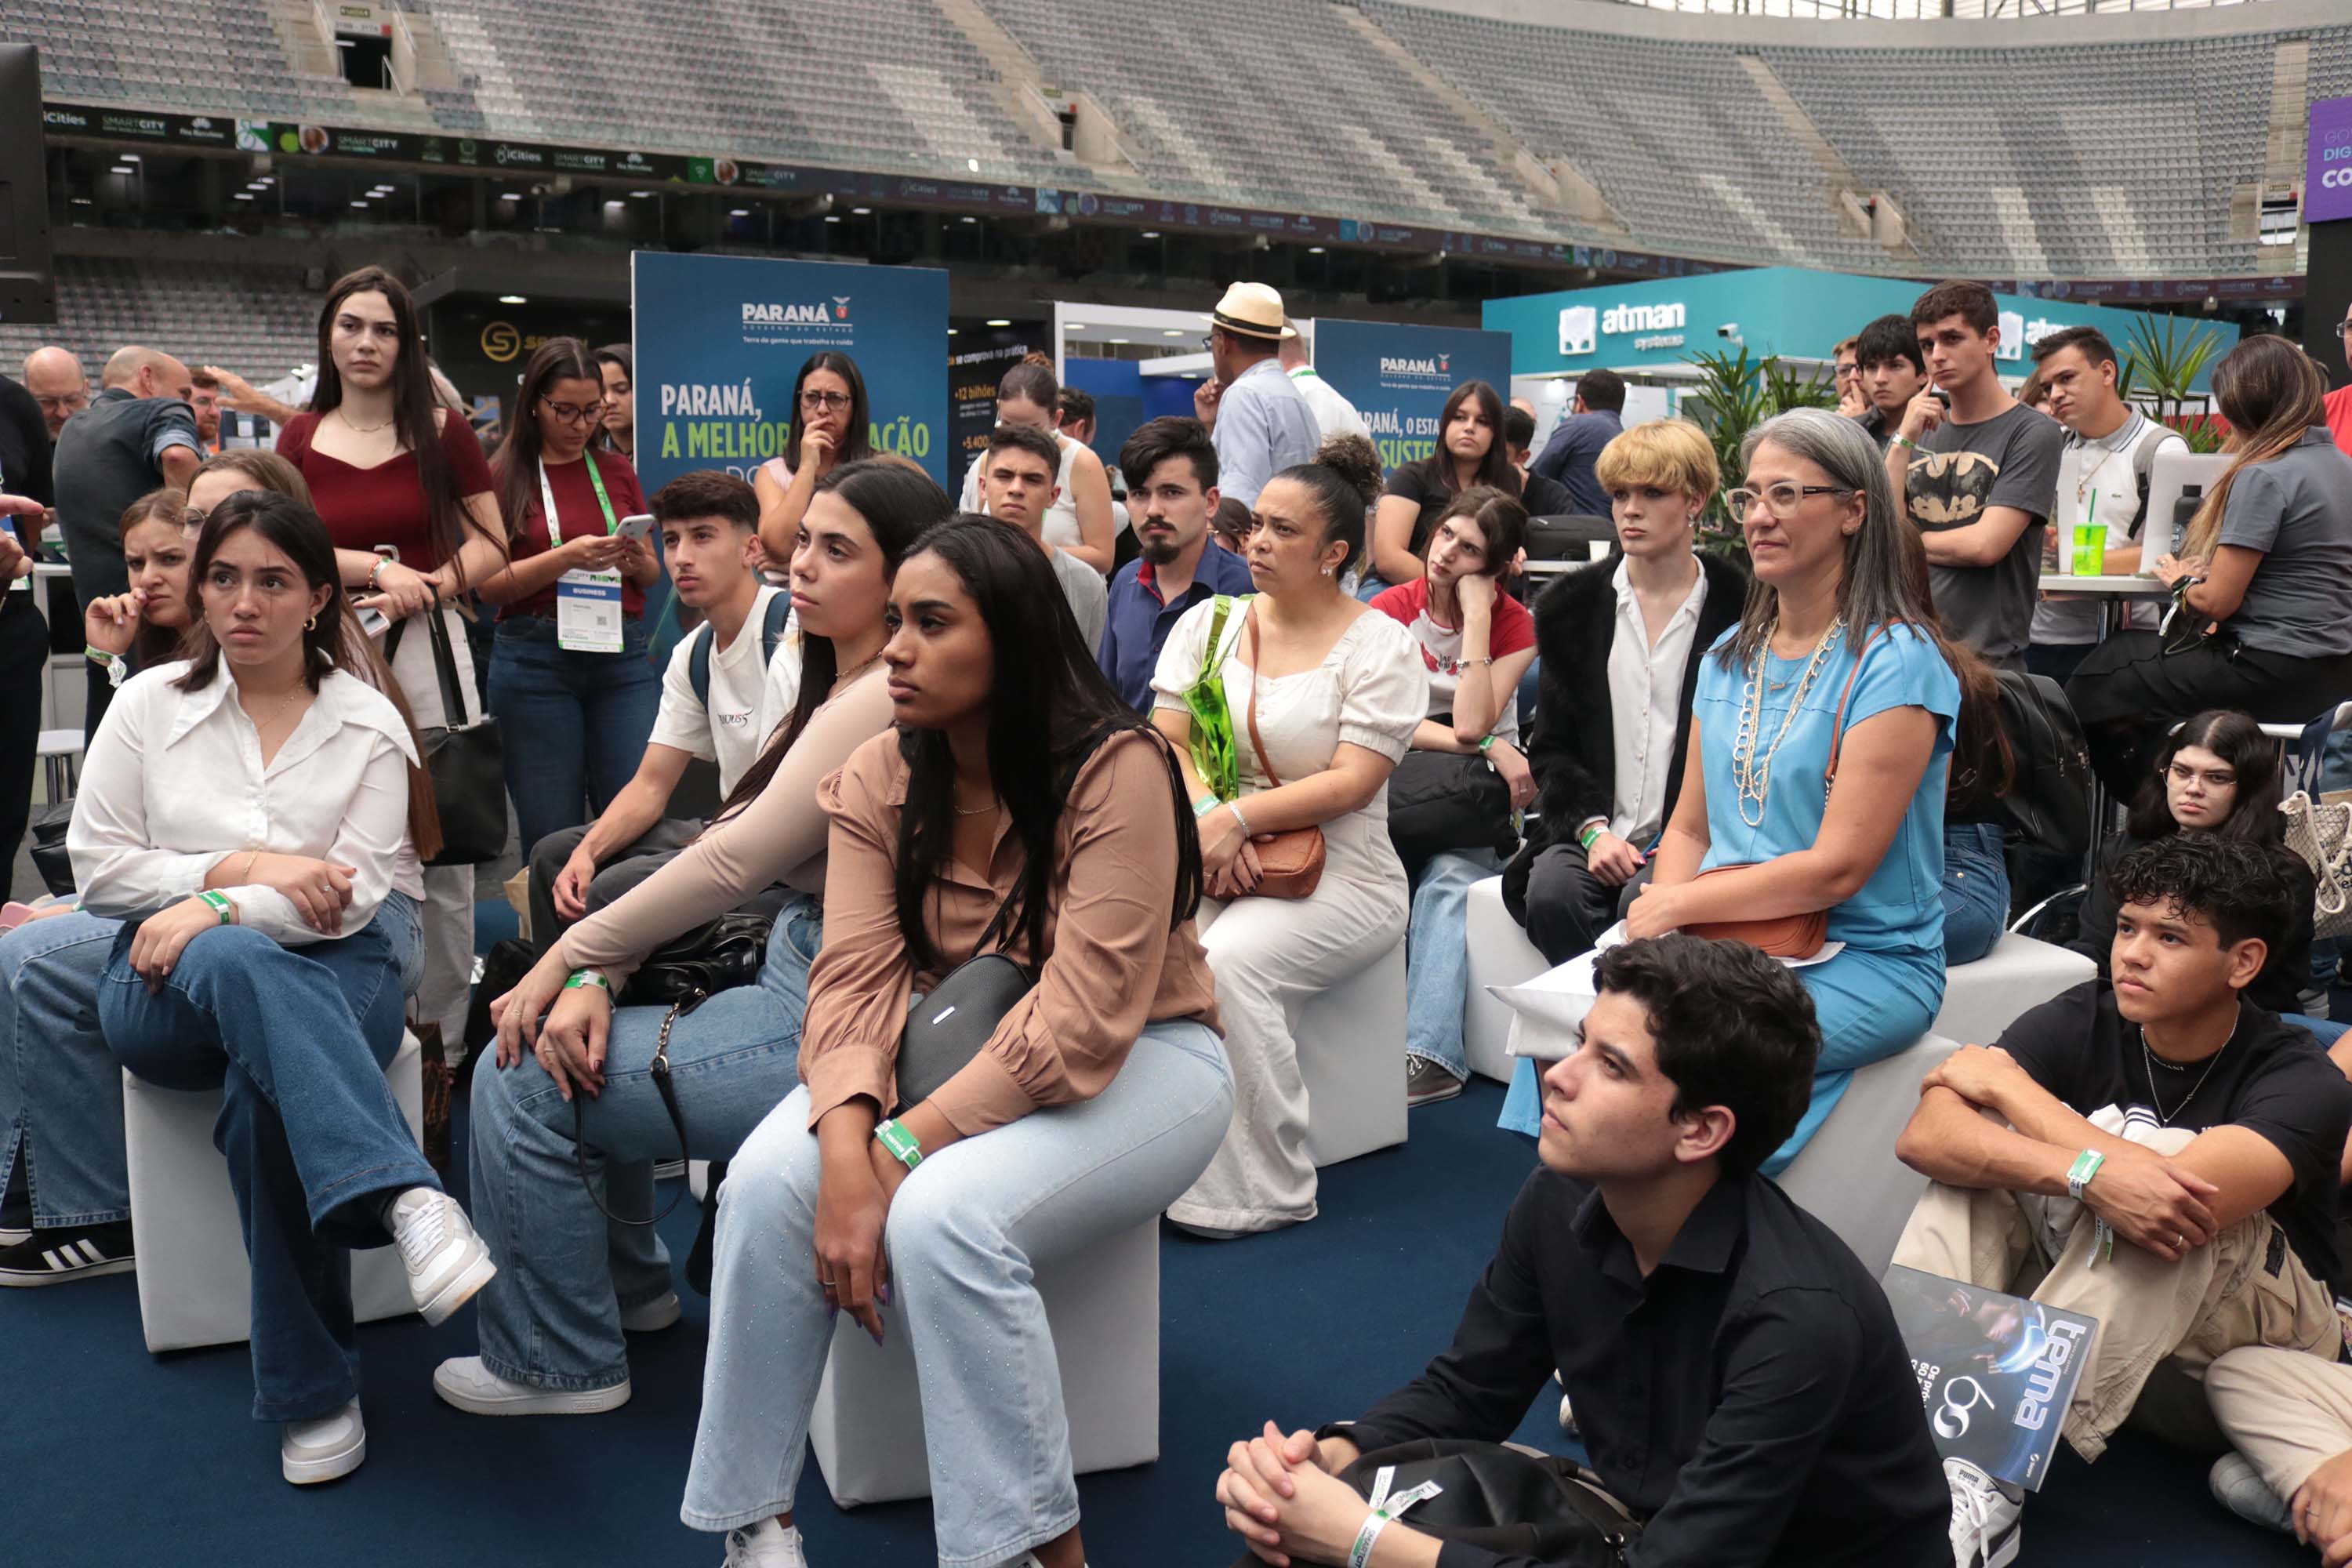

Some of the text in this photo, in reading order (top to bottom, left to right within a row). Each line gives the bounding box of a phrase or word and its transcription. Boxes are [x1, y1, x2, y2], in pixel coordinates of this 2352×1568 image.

[742, 303, 830, 322] PARANÁ
[1602, 303, 1686, 335] atman
[1380, 358, 1436, 373] PARANÁ
[660, 378, 762, 422] PARANÁ,
[1358, 408, 1440, 437] RANÁ, O ESTA
[662, 423, 681, 458] A
[1379, 439, 1436, 469] SUSTE
[572, 587, 607, 596] BUSINESS
[1926, 1365, 1940, 1380] Os
[2014, 1319, 2087, 1431] tema
[1958, 1469, 1980, 1484] PUMA
